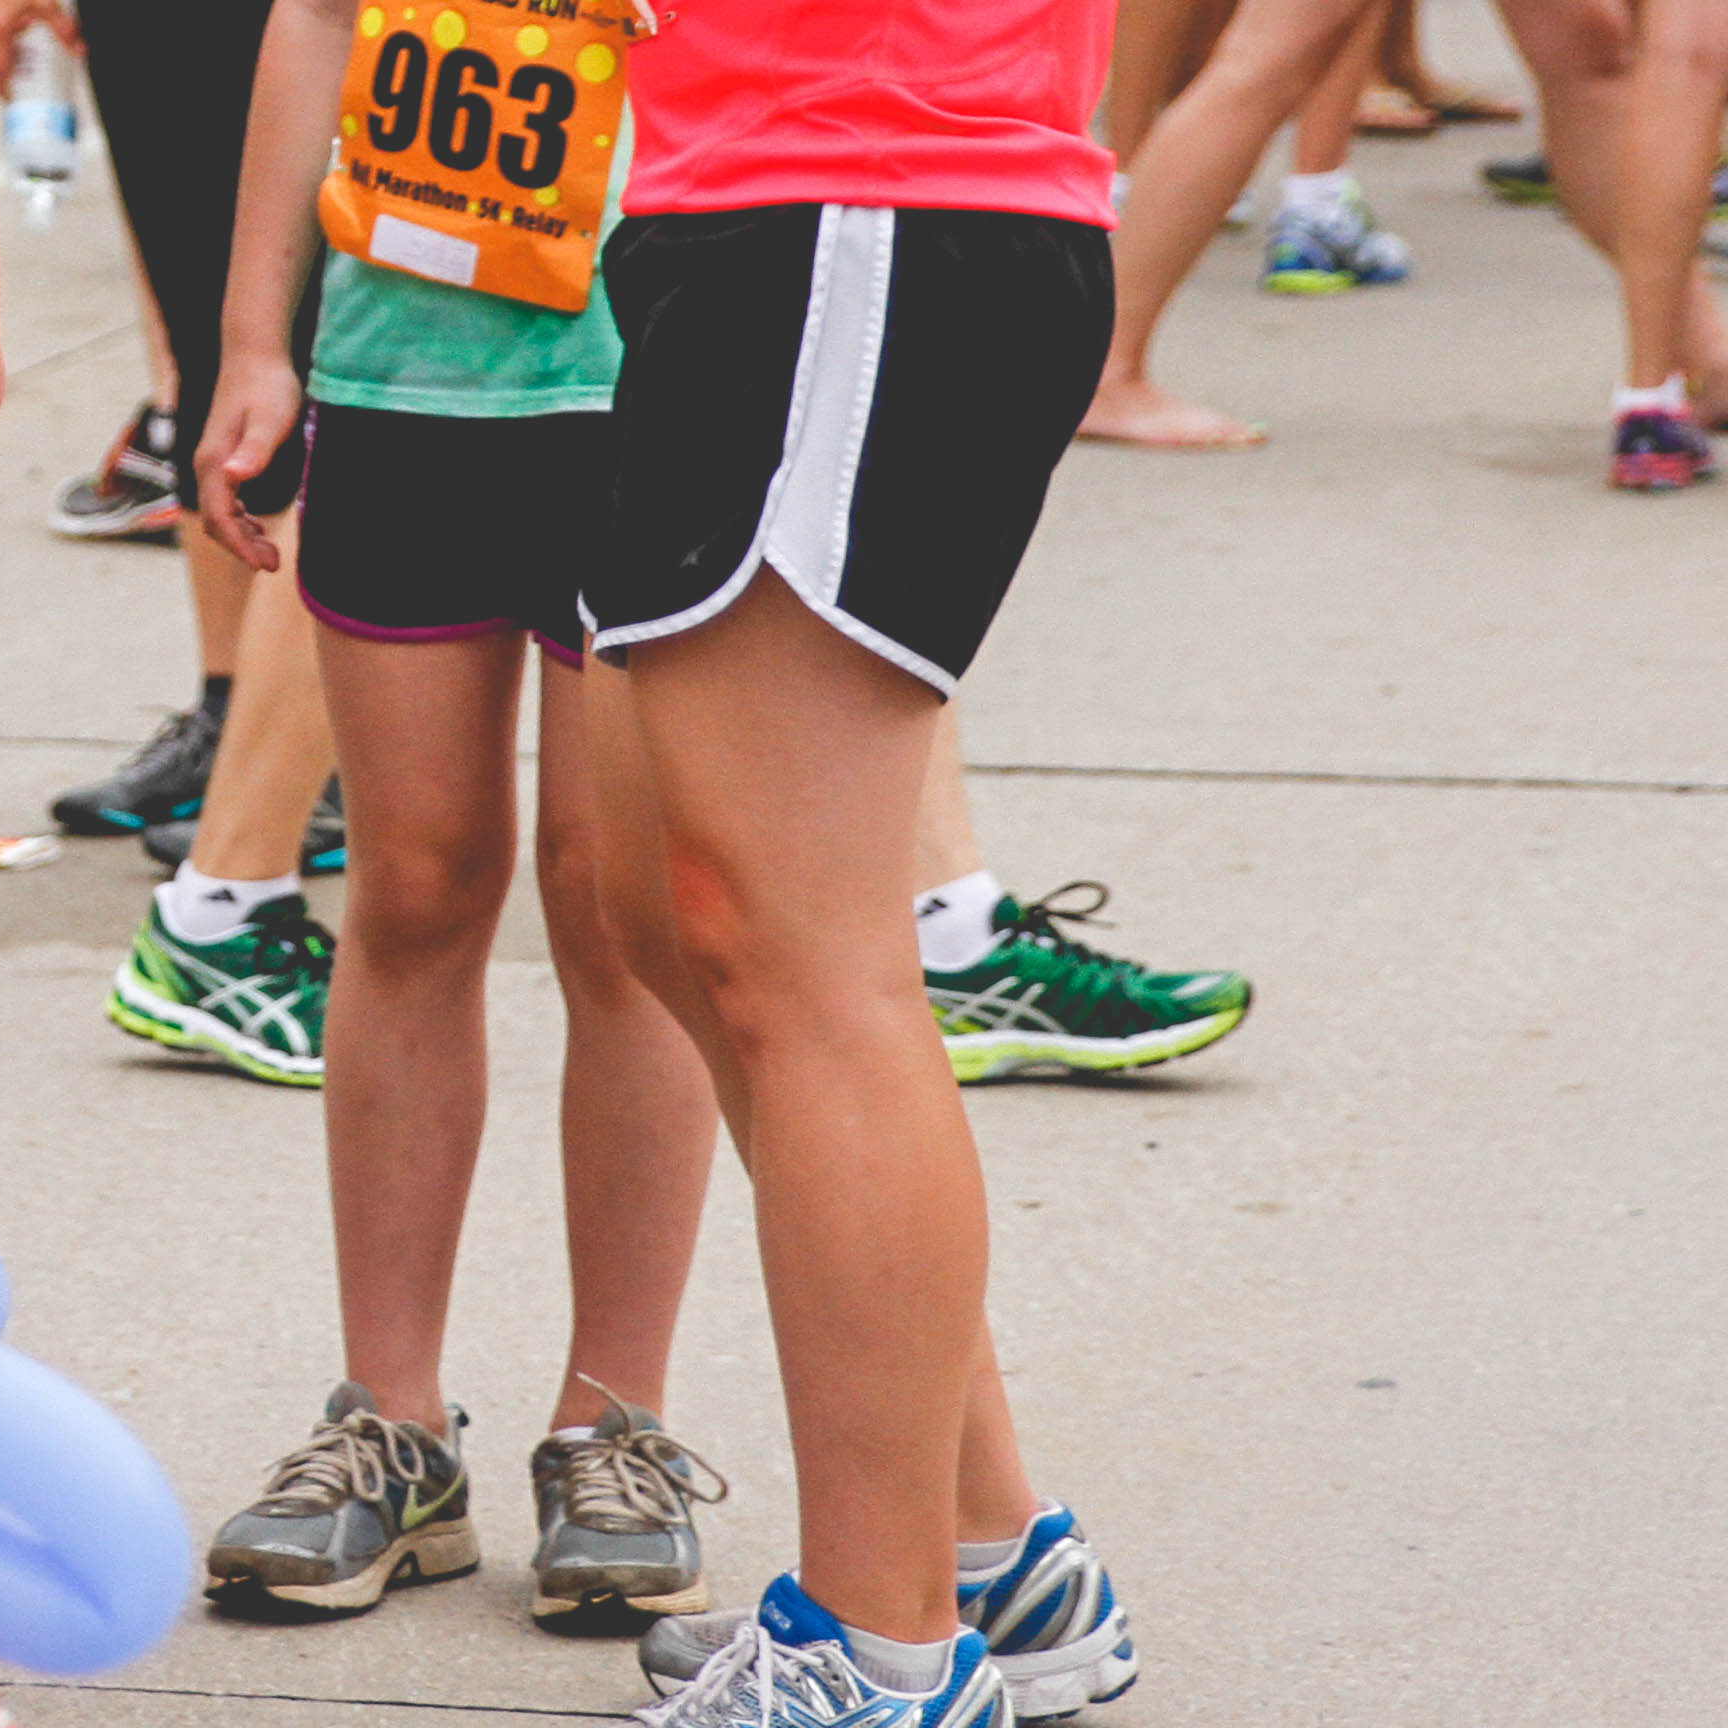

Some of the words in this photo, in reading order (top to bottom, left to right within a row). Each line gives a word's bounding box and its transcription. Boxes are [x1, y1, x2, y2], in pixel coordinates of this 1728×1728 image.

[366, 30, 576, 189] 963
[373, 167, 469, 213] Marathon
[510, 204, 569, 237] Relay
